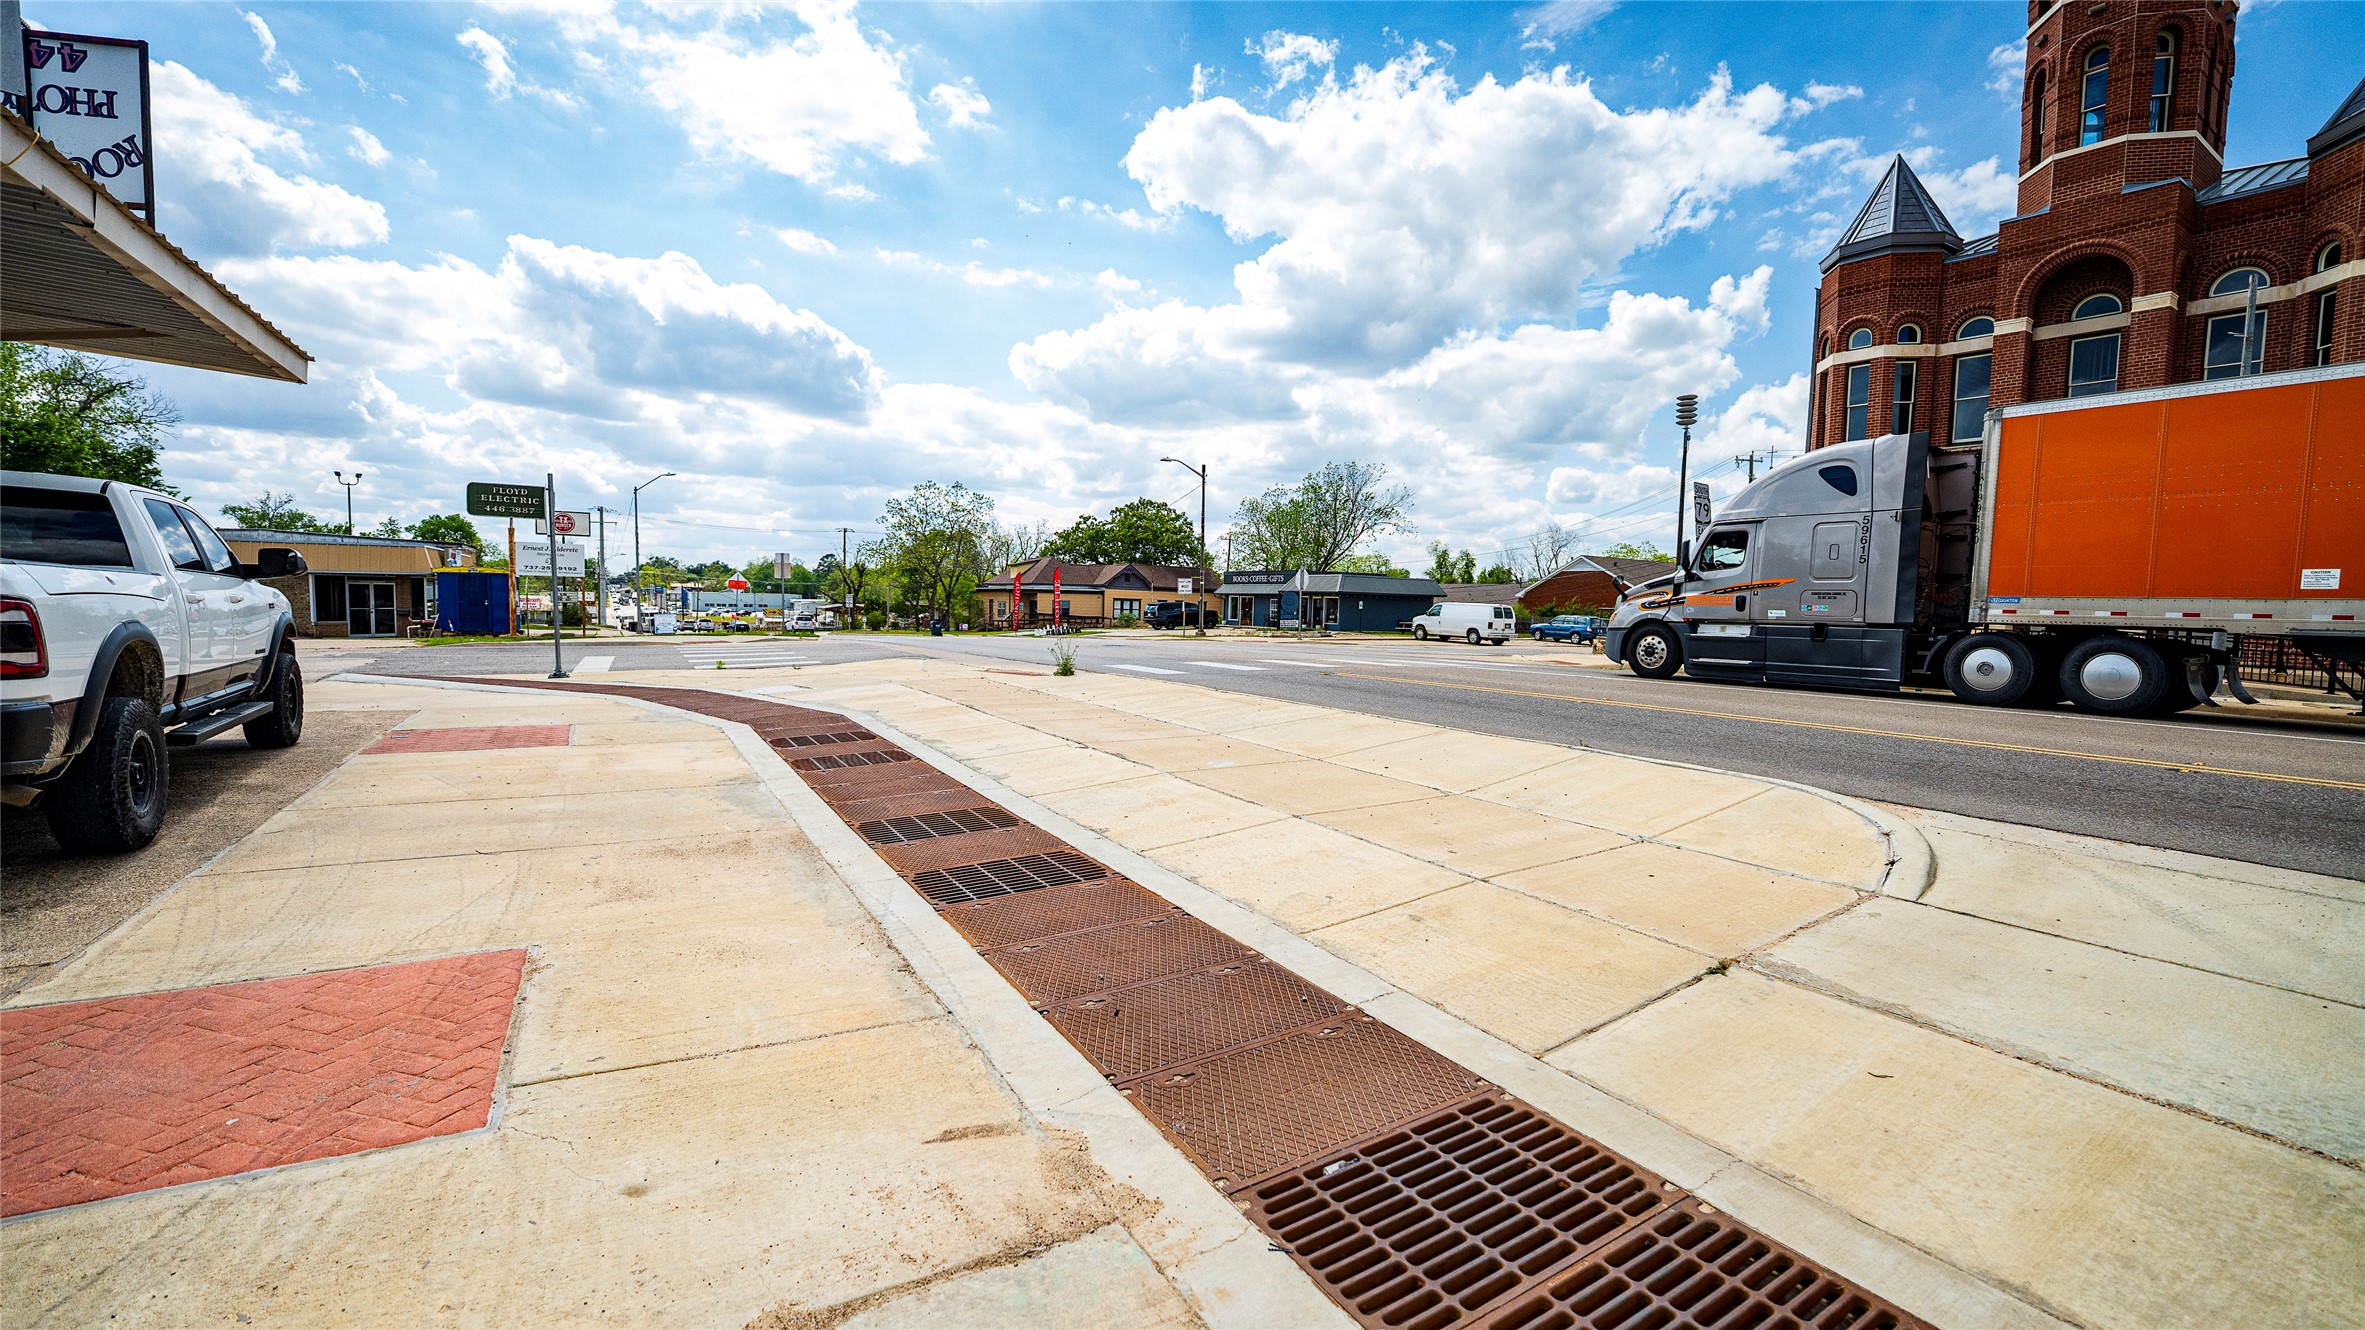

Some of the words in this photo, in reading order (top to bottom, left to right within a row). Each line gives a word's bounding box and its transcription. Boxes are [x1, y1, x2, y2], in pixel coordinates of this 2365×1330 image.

[0, 83, 119, 119] PHO
[493, 486, 528, 495] FLOYD
[481, 494, 540, 505] ELECTRIC
[484, 505, 506, 513] 446
[1696, 502, 1710, 517] 79
[559, 516, 568, 524] TX
[1859, 515, 1870, 564] 59615
